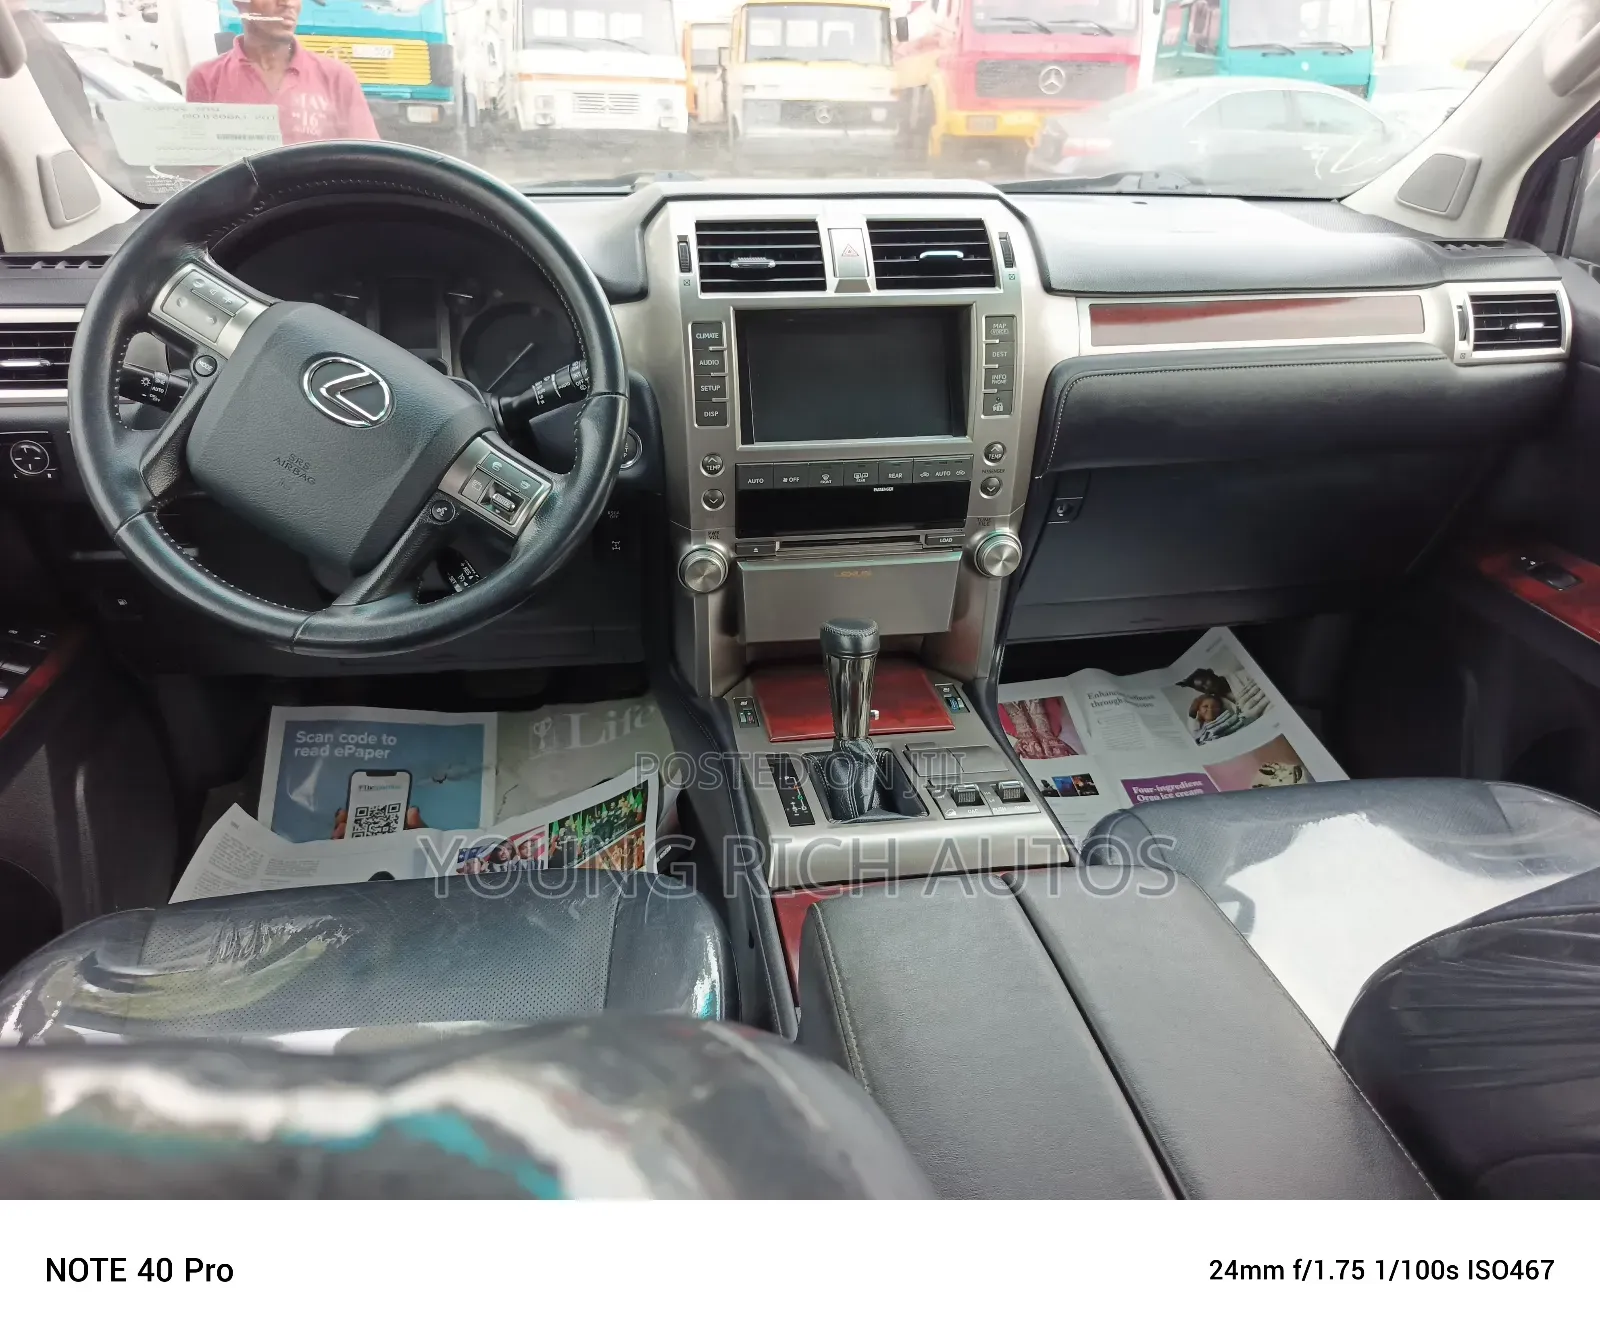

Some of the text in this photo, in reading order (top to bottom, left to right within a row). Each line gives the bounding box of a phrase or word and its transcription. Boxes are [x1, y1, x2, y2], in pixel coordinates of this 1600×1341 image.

[695, 332, 719, 340] CLIMATE
[991, 373, 1007, 381] INFO
[151, 386, 165, 394] AUTO
[700, 384, 721, 392] SETUP
[703, 410, 719, 418] DISP
[287, 453, 311, 471] SRS
[272, 457, 316, 485] AIRBAG
[561, 704, 656, 750] Life
[296, 730, 398, 746] Scan code to
[294, 744, 391, 761] read ePaper
[1131, 780, 1204, 796] Four-ingredient
[1160, 791, 1175, 800] ice
[1174, 788, 1205, 799] cream
